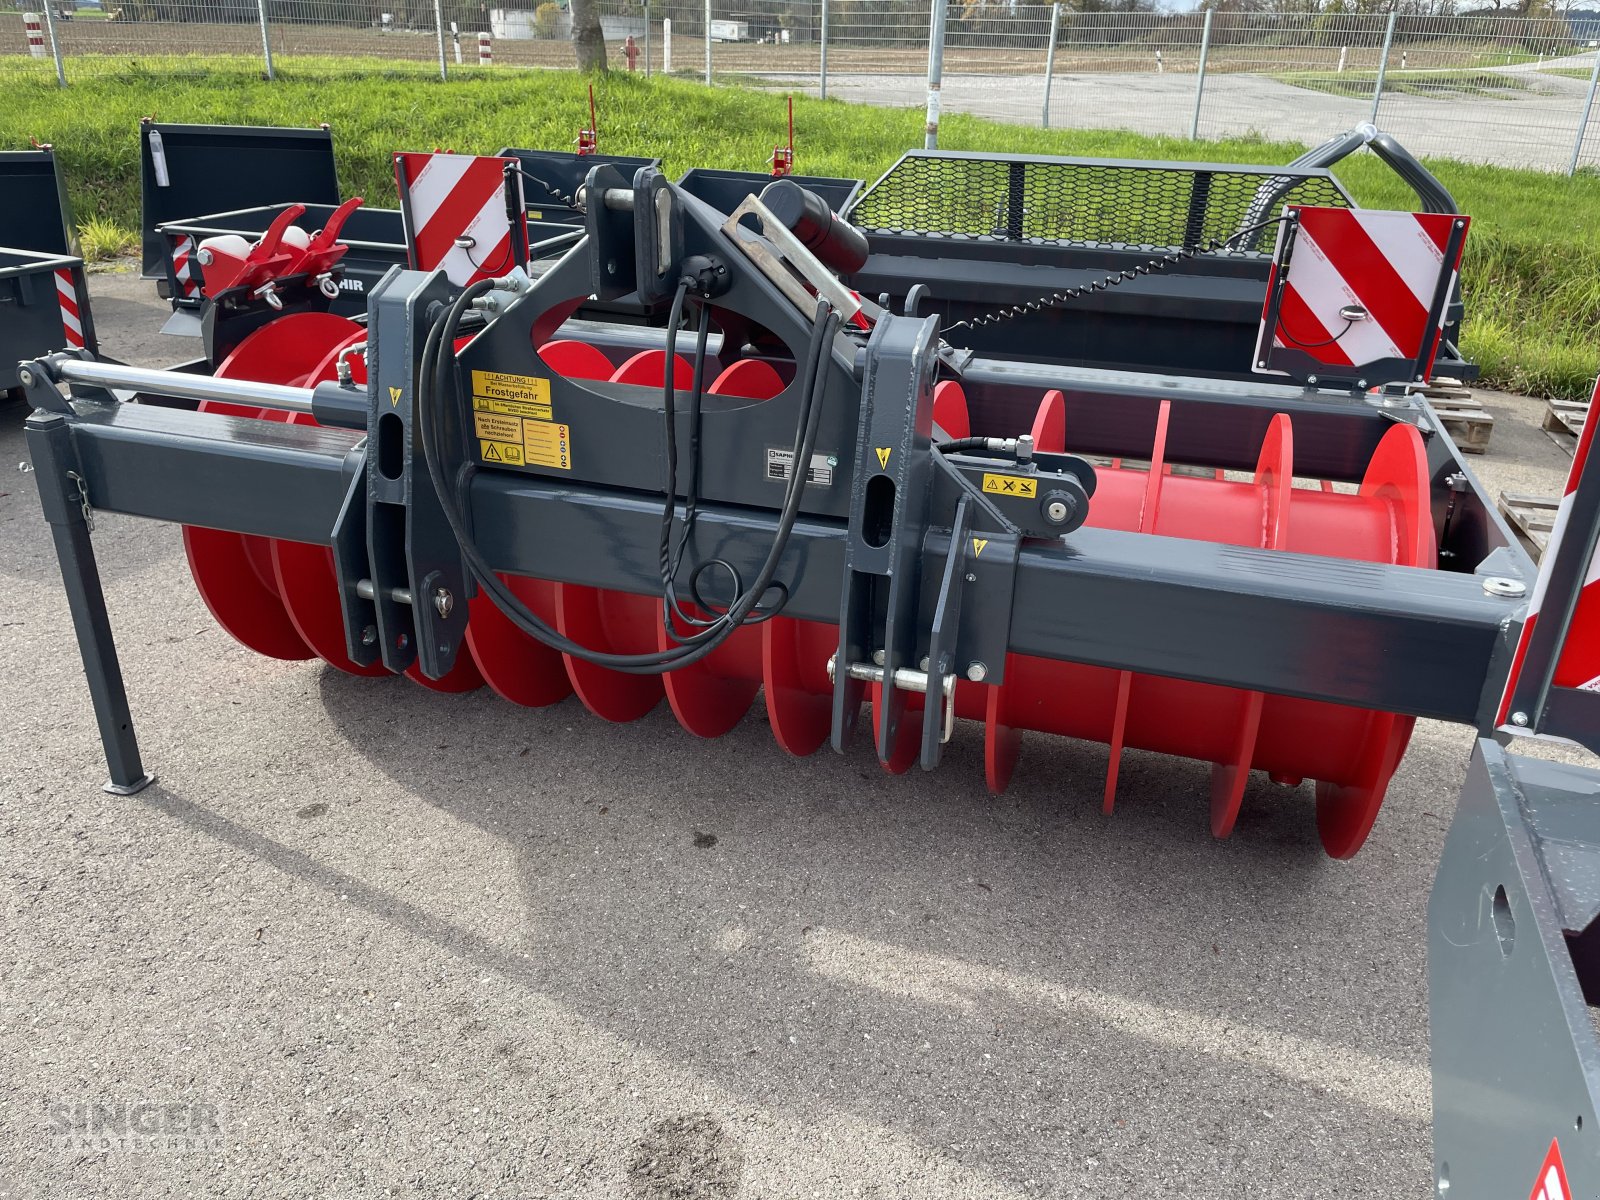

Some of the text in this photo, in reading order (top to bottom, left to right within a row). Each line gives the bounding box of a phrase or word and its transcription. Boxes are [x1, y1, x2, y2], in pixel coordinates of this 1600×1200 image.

[338, 278, 364, 291] HIR
[495, 374, 526, 384] ACHTUNG
[485, 386, 539, 400] Frostgefahr
